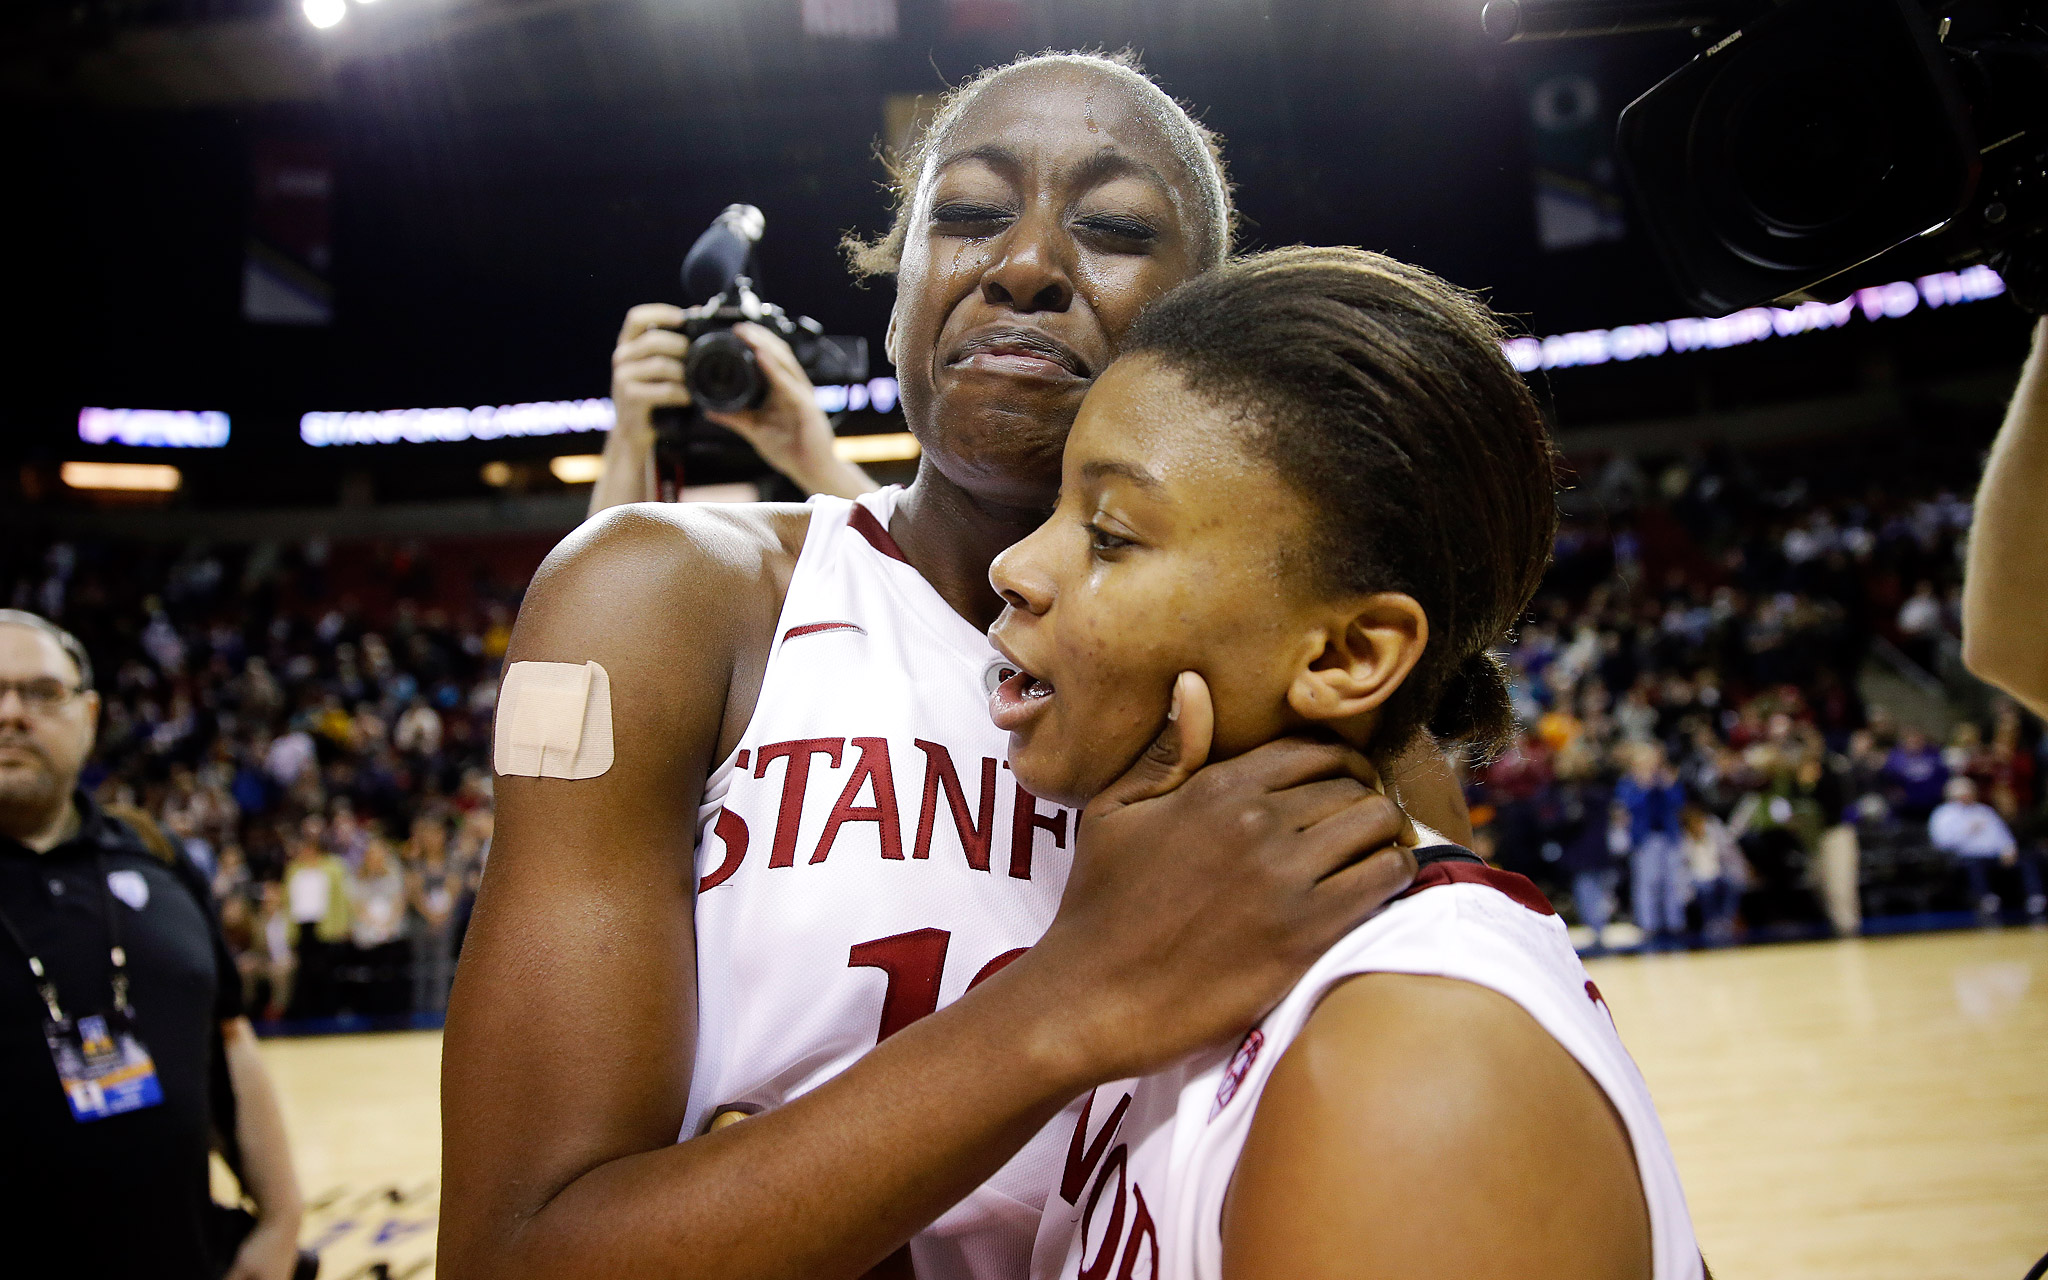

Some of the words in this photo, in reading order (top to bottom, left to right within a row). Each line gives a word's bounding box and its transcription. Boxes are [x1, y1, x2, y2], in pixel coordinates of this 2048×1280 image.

[468, 398, 616, 441] CARDINA
[698, 737, 1083, 894] STANF
[848, 927, 1033, 1046] 1
